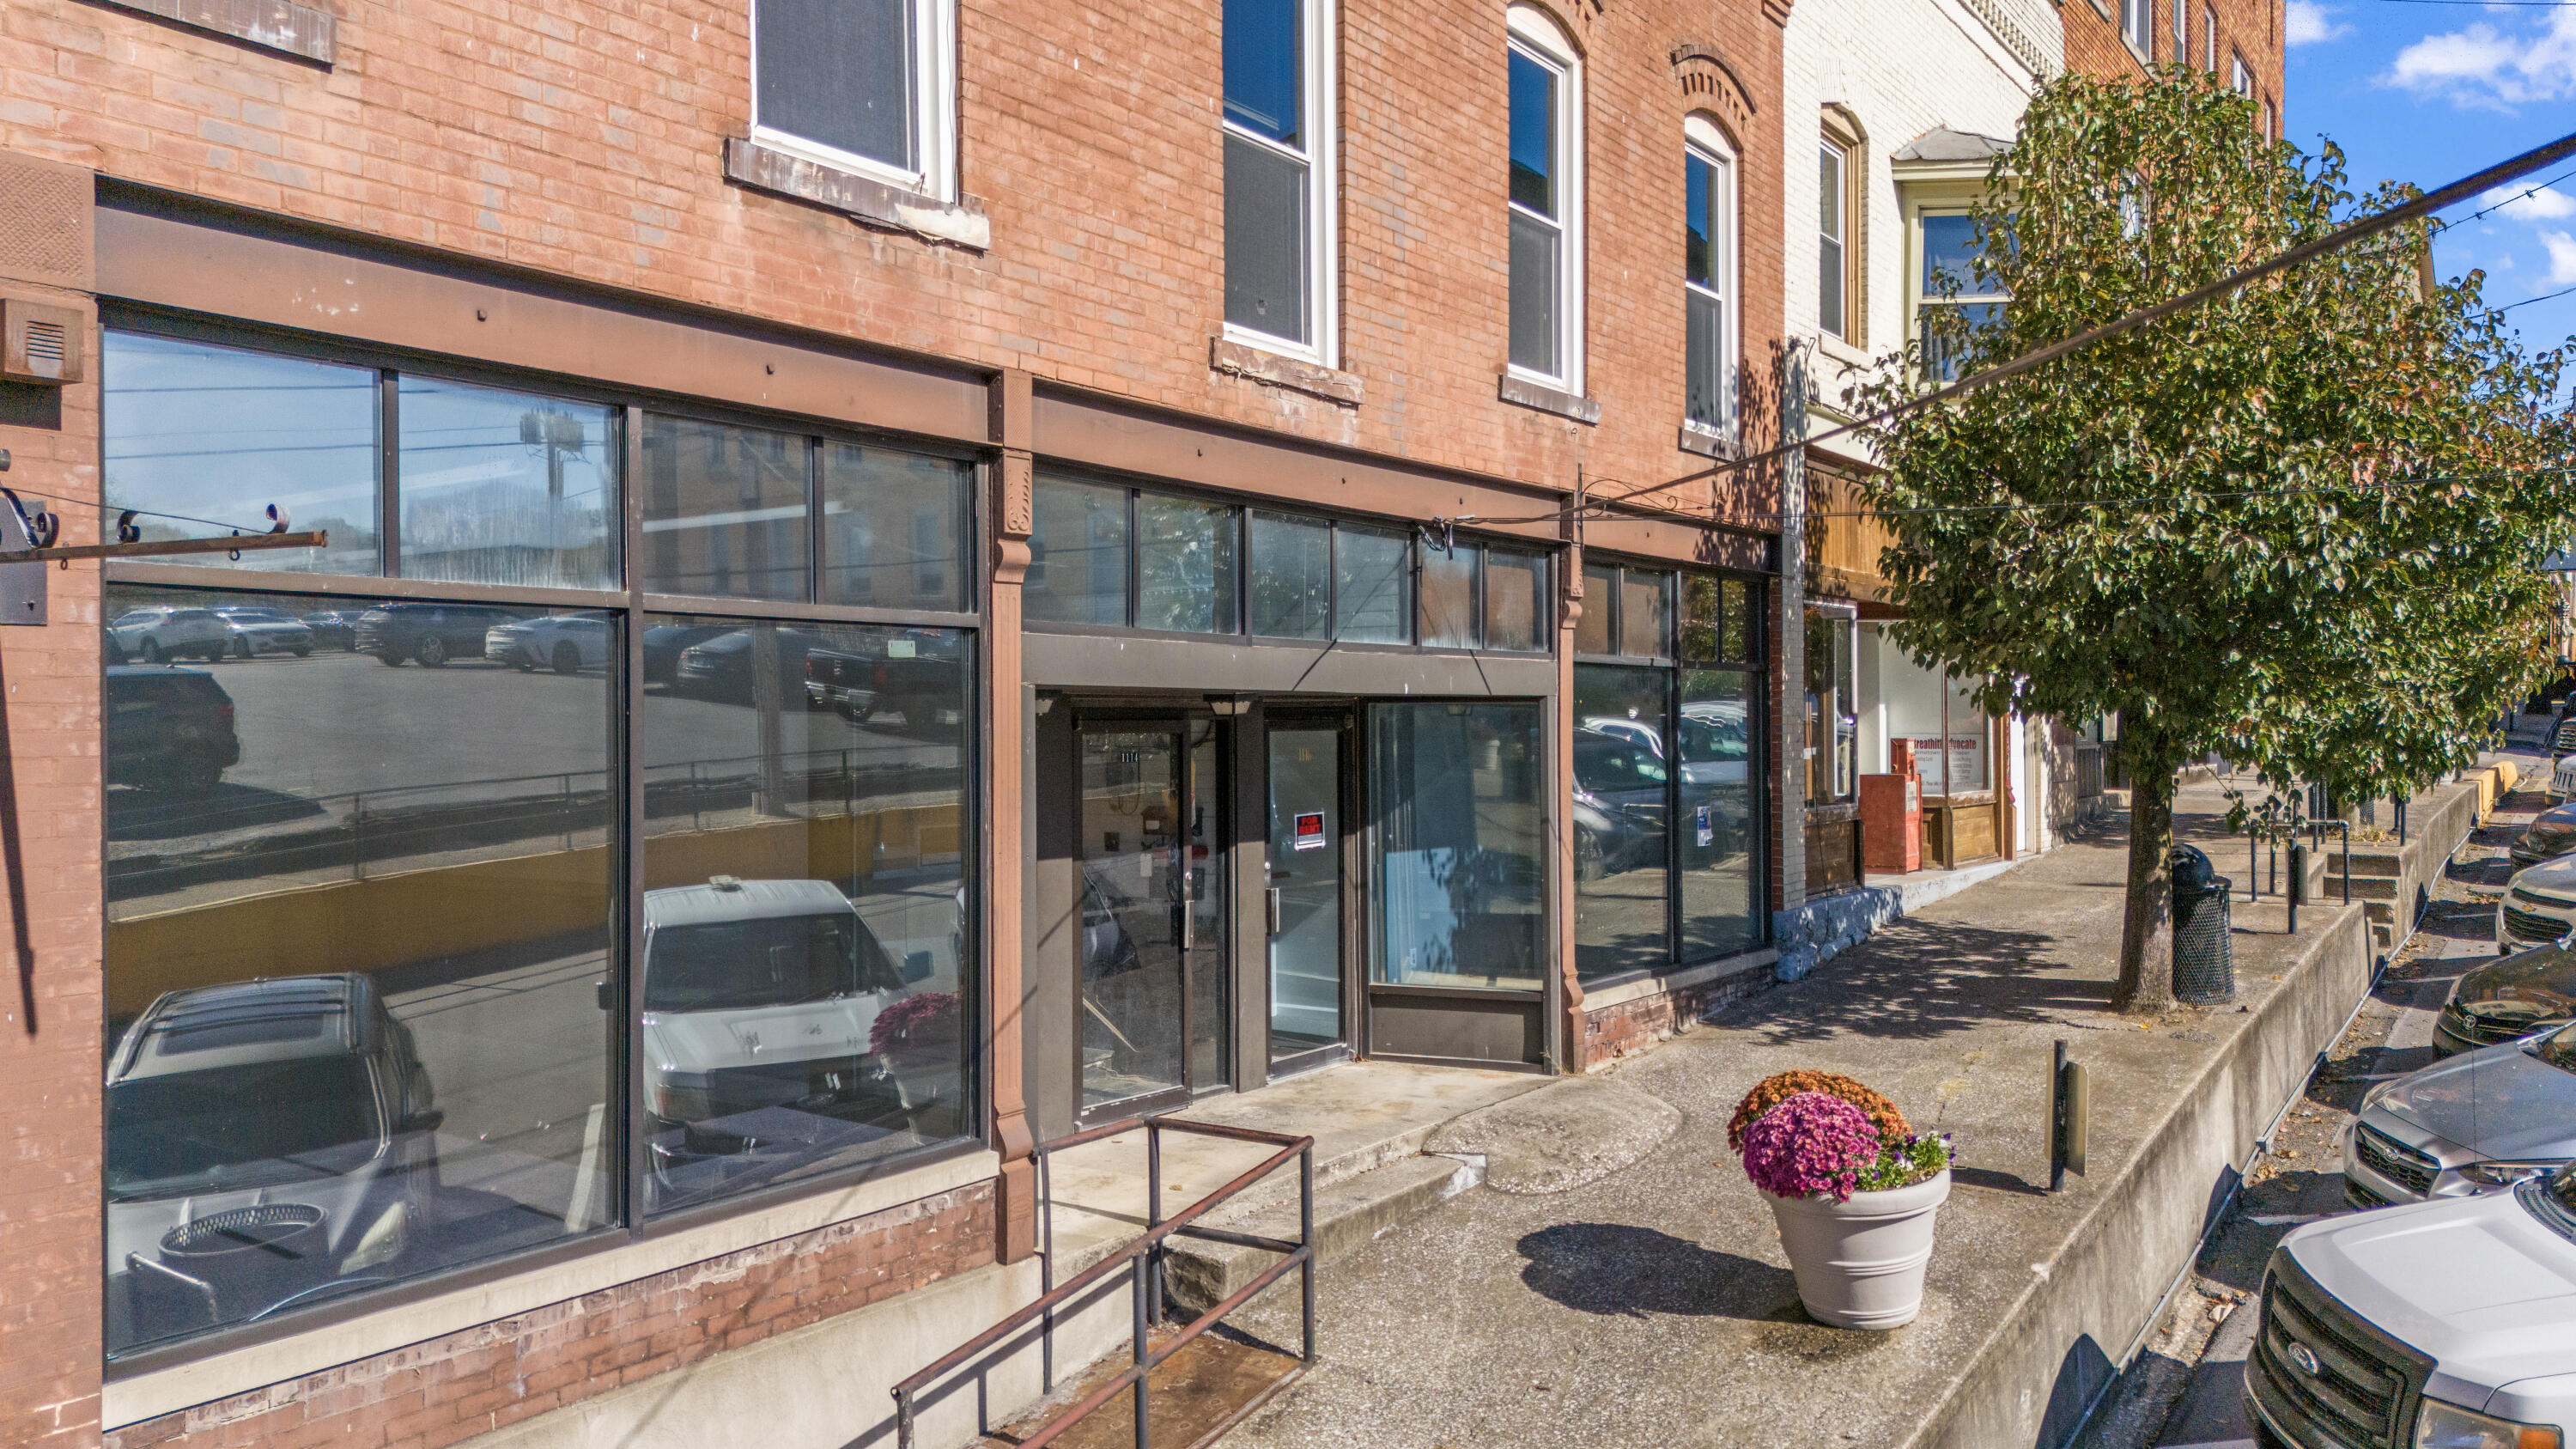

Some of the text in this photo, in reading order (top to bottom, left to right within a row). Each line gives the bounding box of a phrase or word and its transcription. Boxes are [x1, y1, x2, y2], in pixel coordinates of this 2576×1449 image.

[1948, 738, 1977, 750] dvocate
[1301, 816, 1318, 825] FOR
[1298, 824, 1321, 835] RENT
